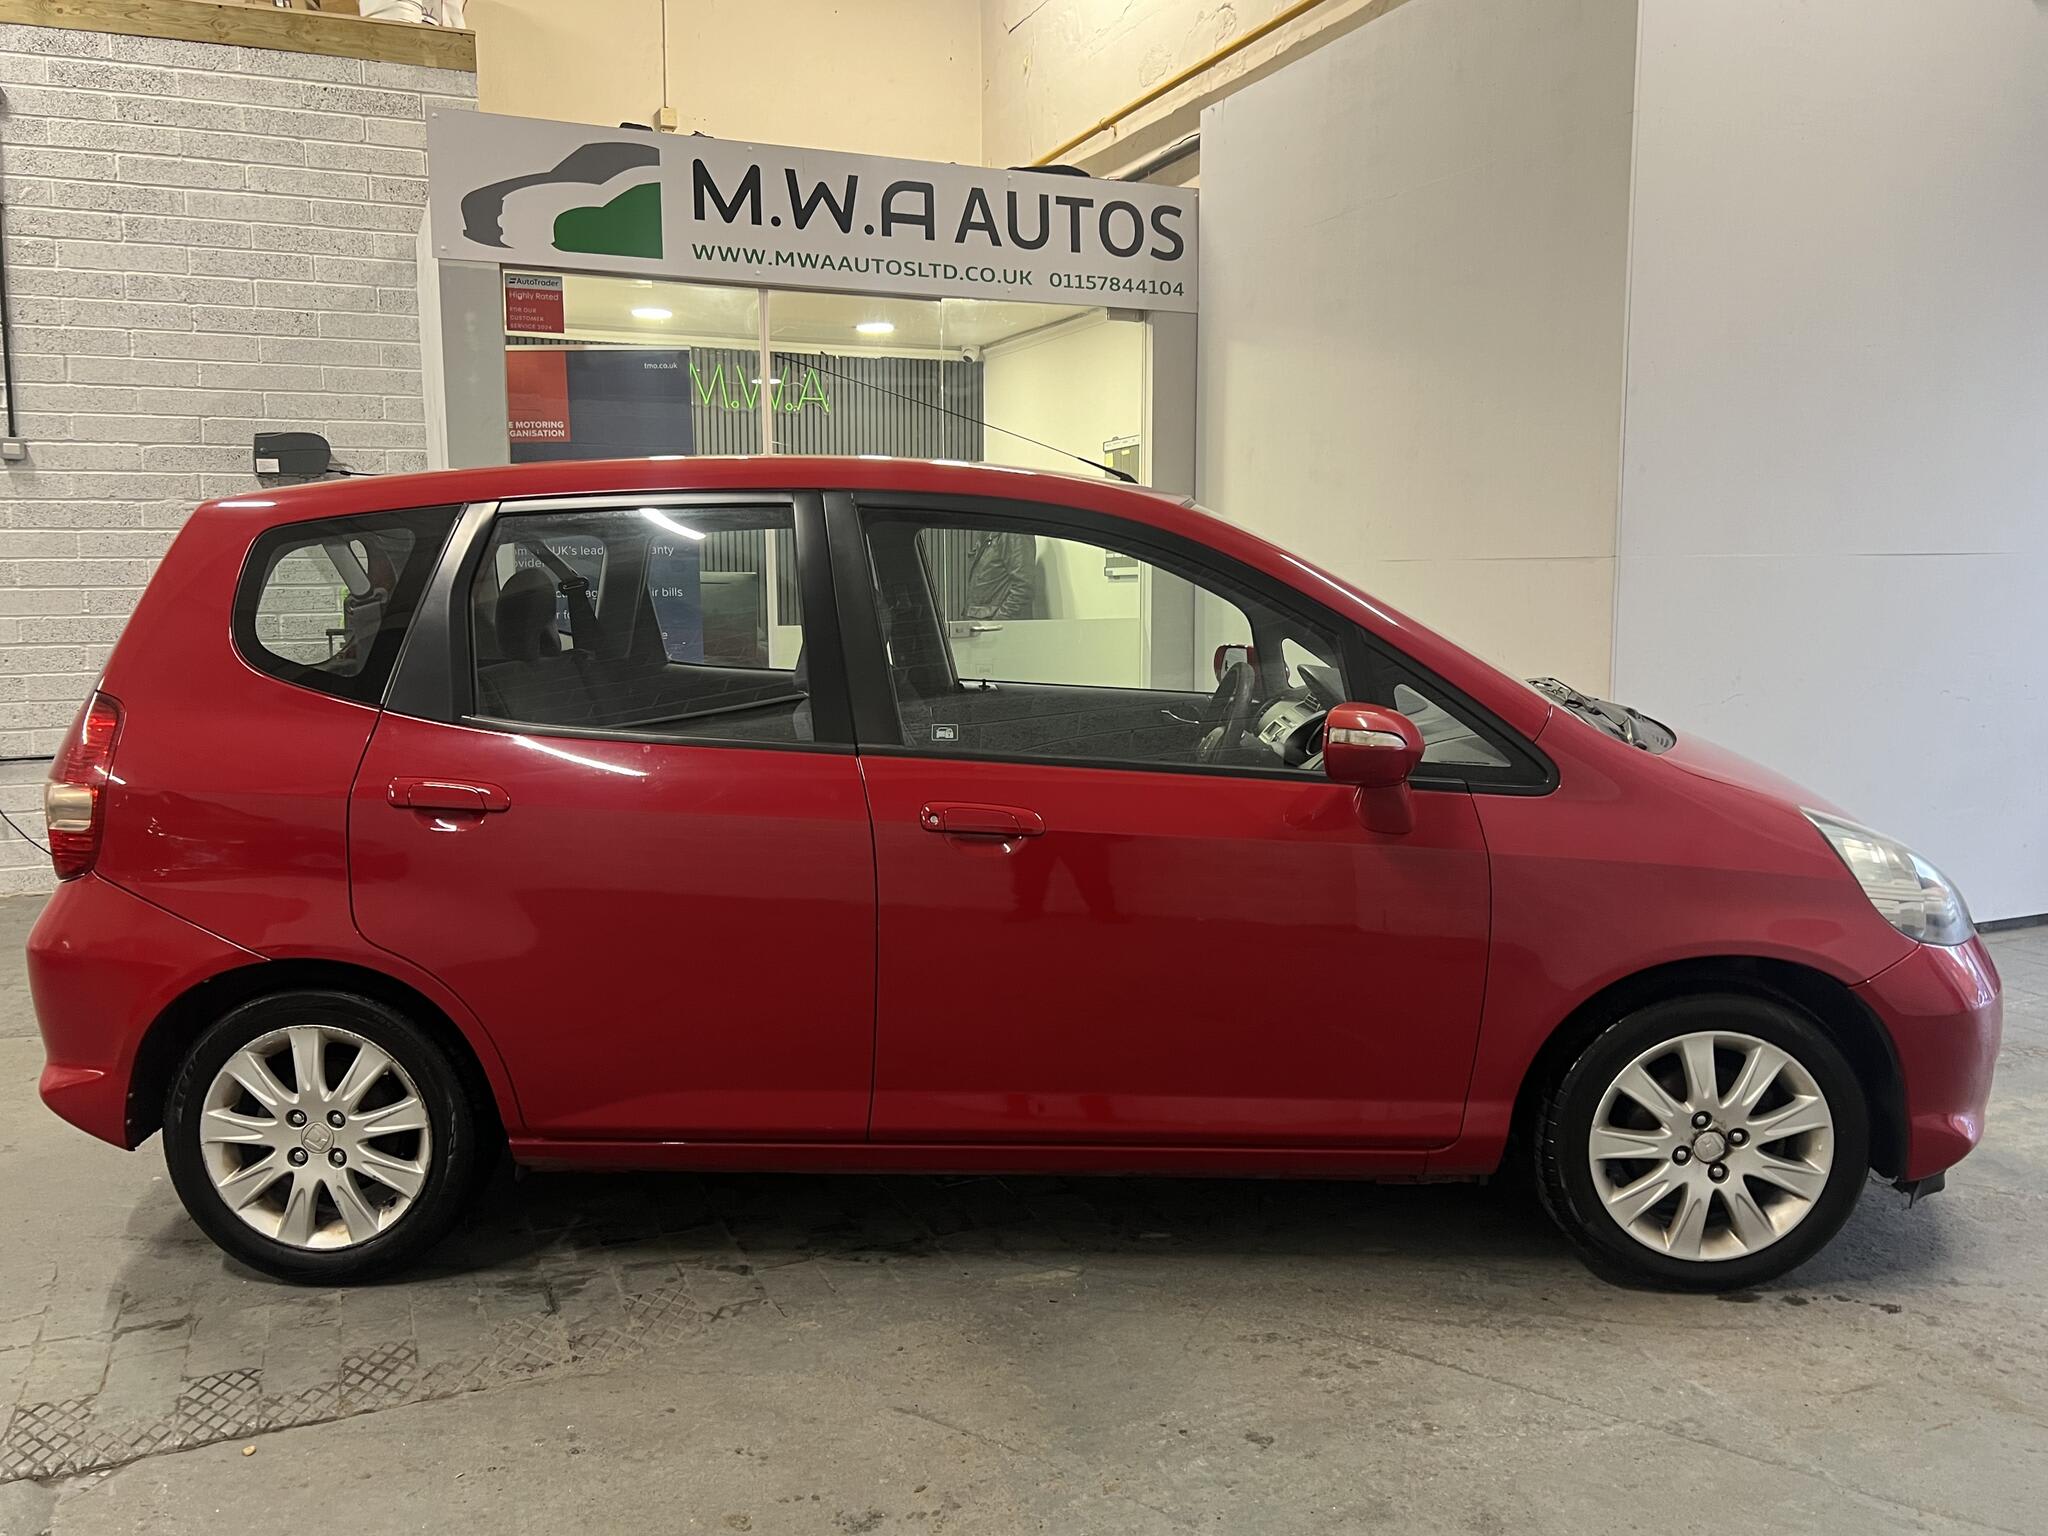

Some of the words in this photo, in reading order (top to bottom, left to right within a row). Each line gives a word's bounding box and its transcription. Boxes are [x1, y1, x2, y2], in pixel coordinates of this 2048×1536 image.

[692, 158, 936, 241] M.W.A
[954, 186, 1185, 262] AUTOS
[691, 242, 1033, 286] WWW.MWAAUTOSLTD.CO.UK
[1048, 271, 1185, 297] 01157844104
[516, 277, 560, 287] AutoTrader
[509, 290, 535, 301] Highly
[535, 292, 559, 301] Rated
[509, 314, 545, 322] CUSTOMER
[515, 420, 565, 430] MOTORING
[509, 428, 566, 438] GANISATION
[580, 545, 604, 556] lead
[651, 545, 674, 557] anty
[661, 586, 684, 598] bills
